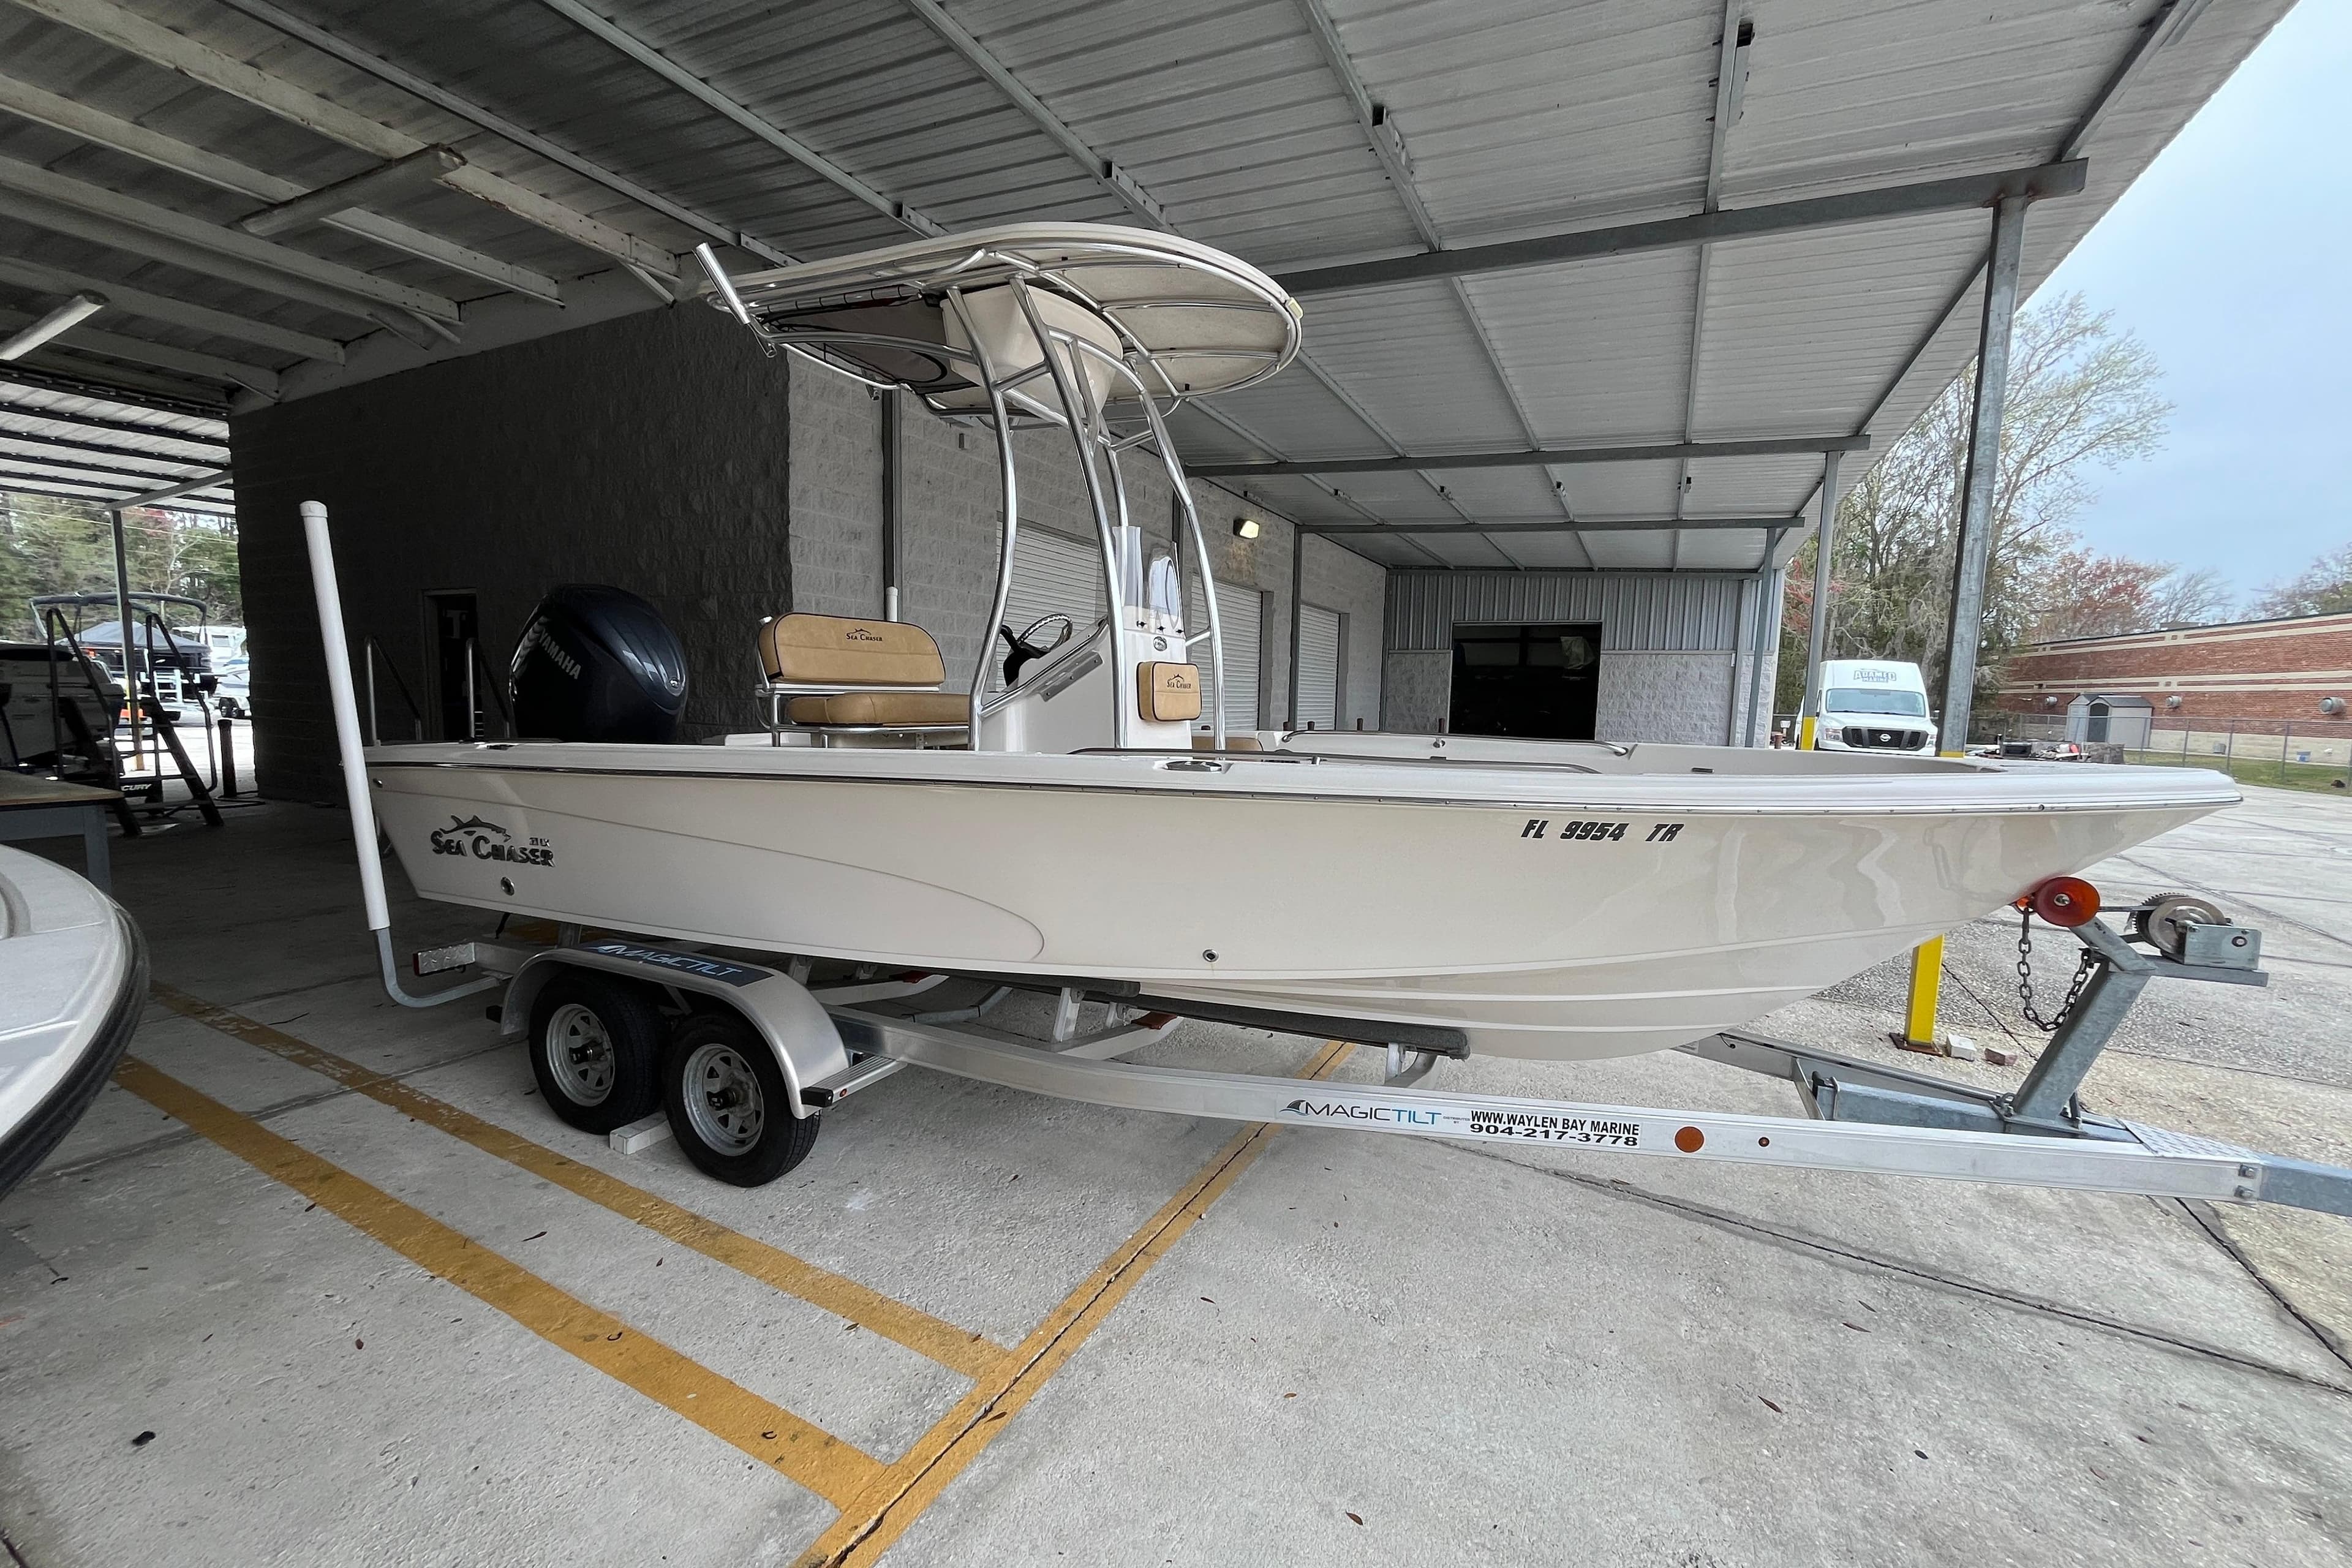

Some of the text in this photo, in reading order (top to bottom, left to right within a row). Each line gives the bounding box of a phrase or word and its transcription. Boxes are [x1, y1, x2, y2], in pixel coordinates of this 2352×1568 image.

[539, 628, 581, 679] YAMAHA
[1520, 819, 1685, 842] FL 9954 TR
[431, 830, 555, 868] SEA CHASER
[612, 945, 743, 976] MAGICTILT
[1305, 1101, 1442, 1125] MAGICTILT
[1471, 1110, 1640, 1136] WWW.WAYLEN BAY MARINE
[1470, 1123, 1638, 1147] 904-217-3778
